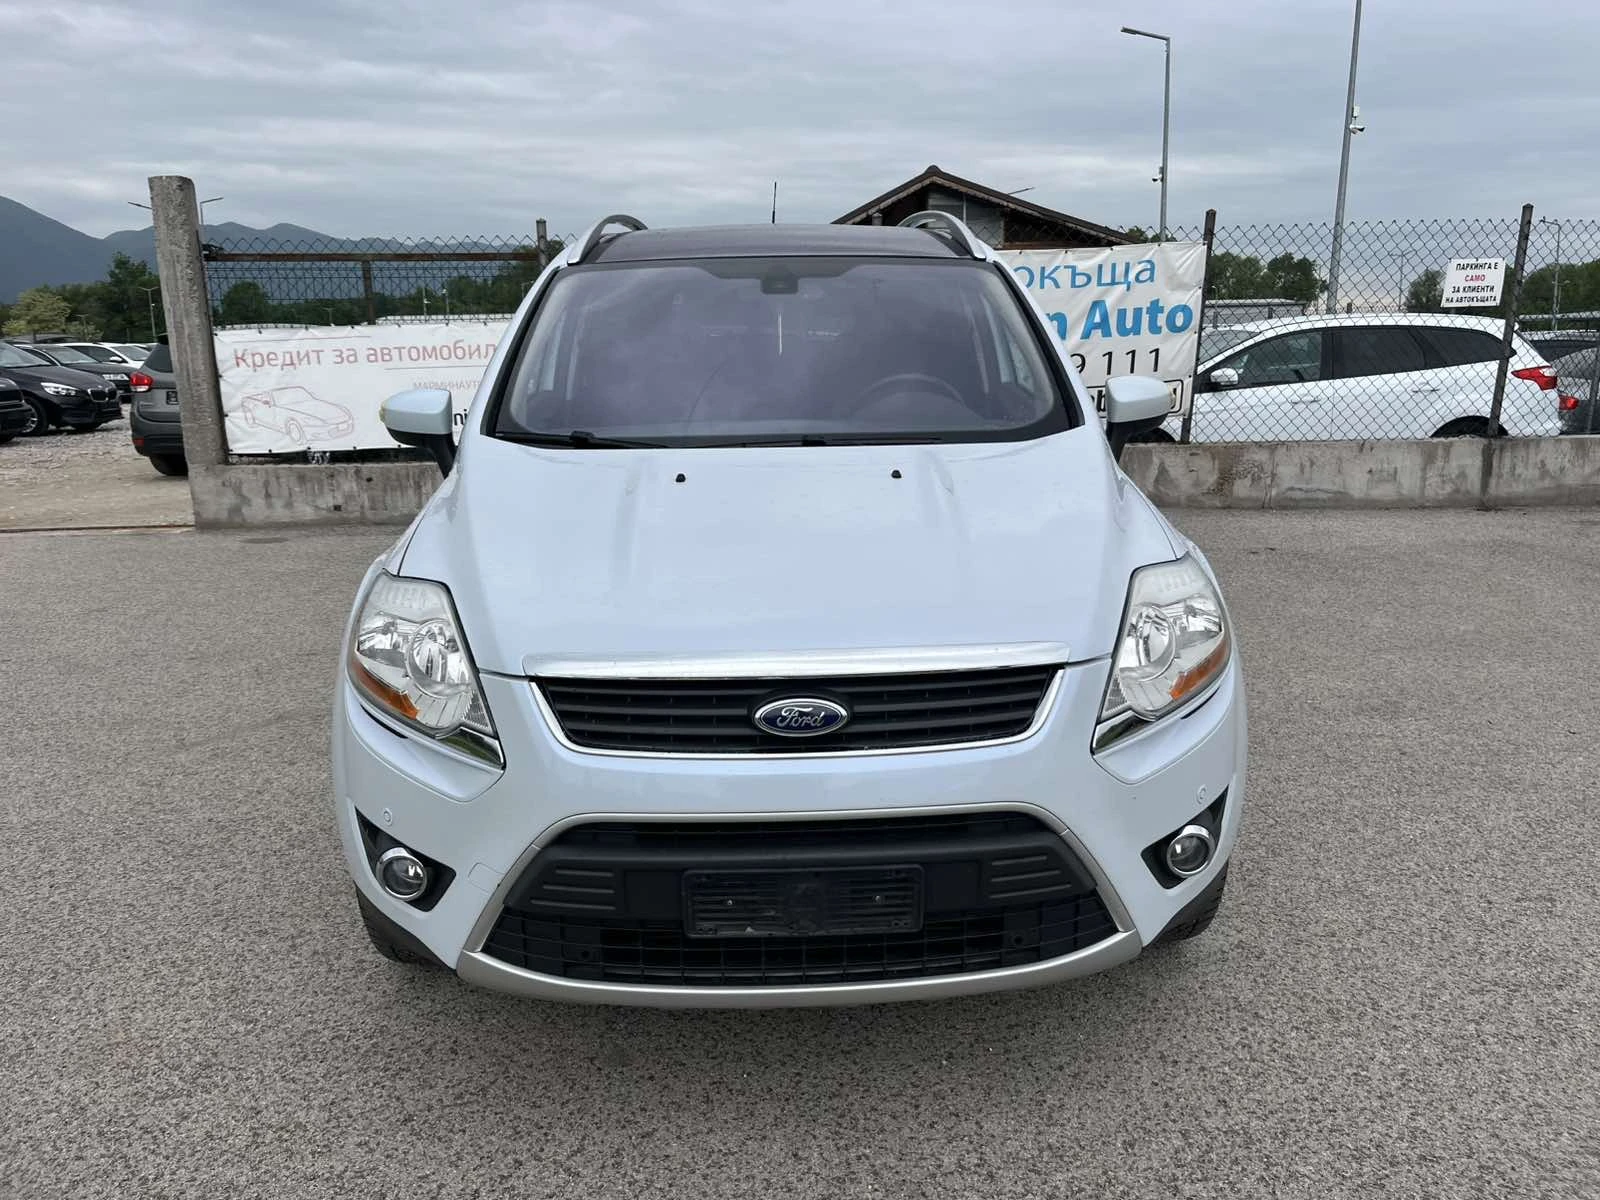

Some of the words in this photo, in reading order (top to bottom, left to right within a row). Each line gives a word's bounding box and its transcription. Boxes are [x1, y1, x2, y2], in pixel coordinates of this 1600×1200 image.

[1456, 262, 1492, 271] ПАРКИНГА
[1494, 262, 1499, 270] Е
[1465, 274, 1486, 282] САМО
[1452, 285, 1460, 294] ЗА
[1462, 285, 1494, 293] КЛИЕНТИ
[1455, 295, 1496, 303] АВТОКЪЩАТА
[1080, 298, 1193, 340] Auto
[233, 347, 324, 372] Кредит
[332, 347, 359, 364] за
[776, 706, 825, 728] Ford
